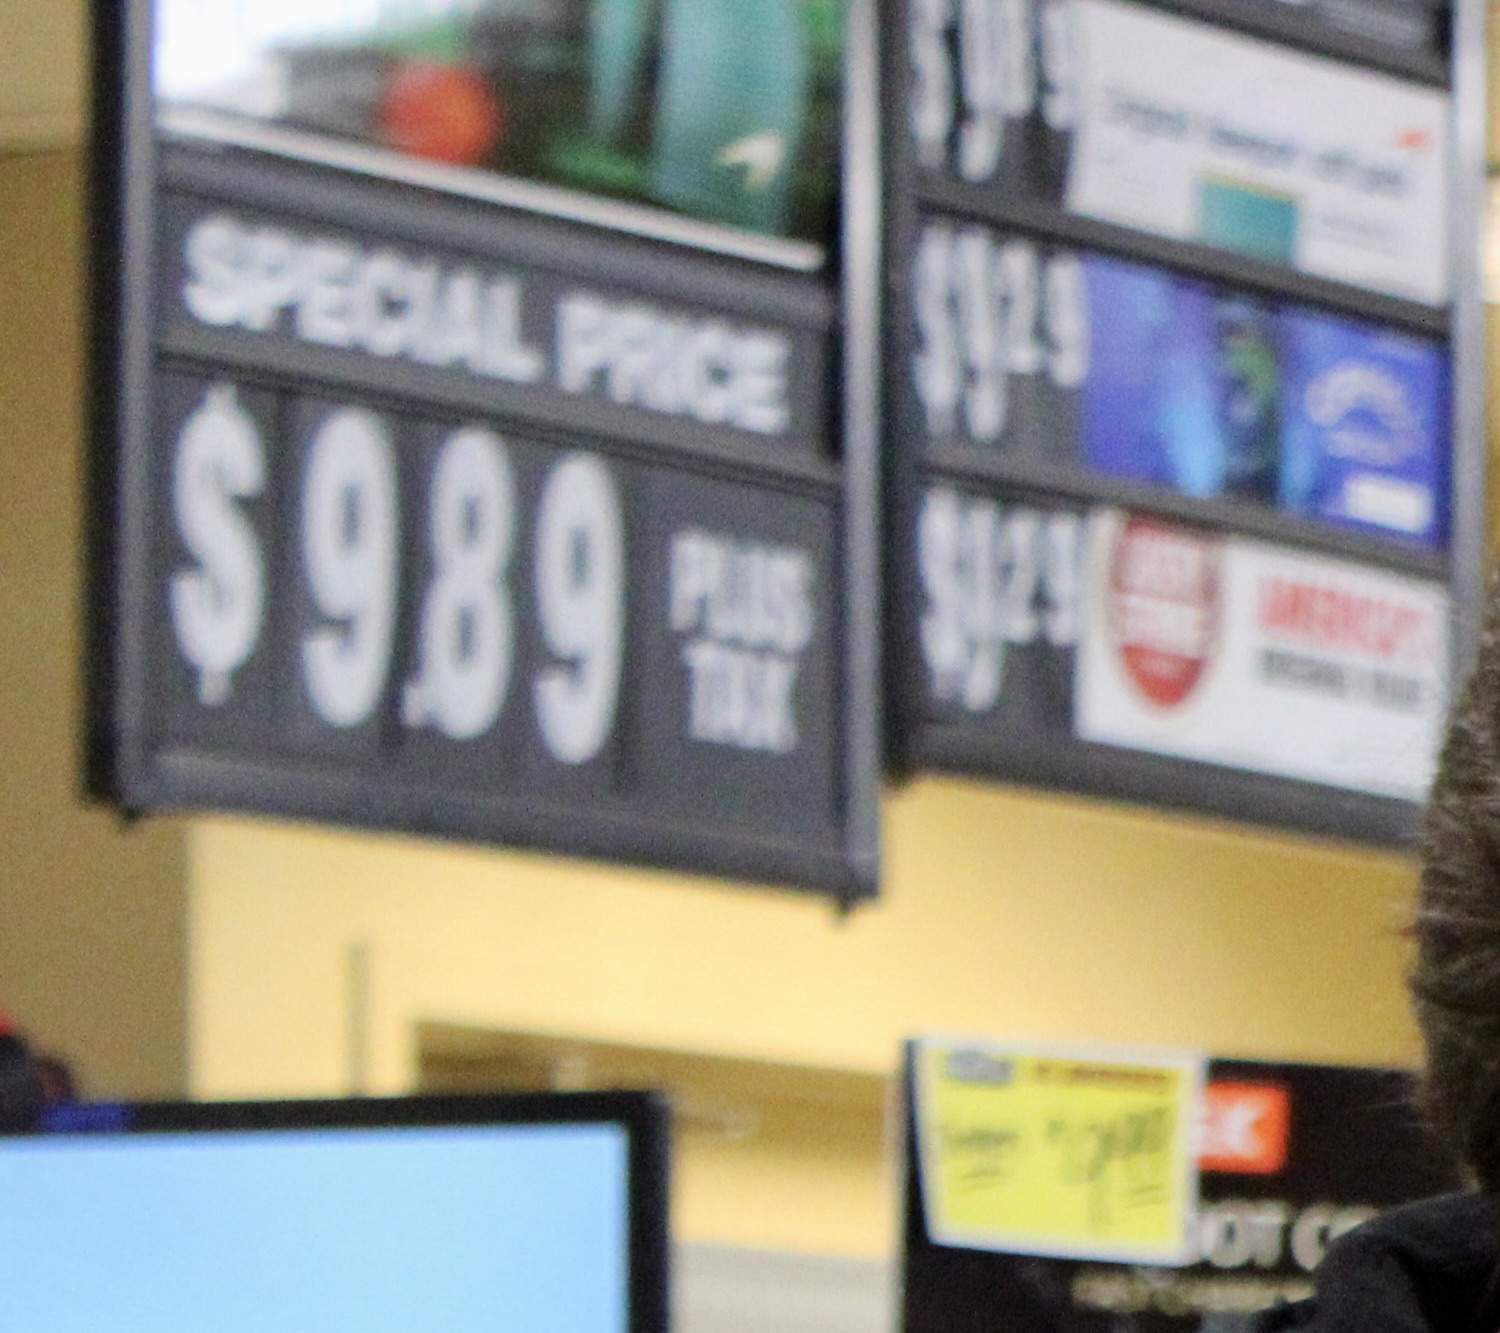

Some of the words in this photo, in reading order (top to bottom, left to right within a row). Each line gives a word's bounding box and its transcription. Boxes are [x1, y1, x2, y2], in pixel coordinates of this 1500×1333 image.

[181, 214, 545, 382] SPECIAL
[556, 294, 790, 436] PRICE
[667, 531, 814, 655] PLUS
[682, 643, 800, 752] TAX
